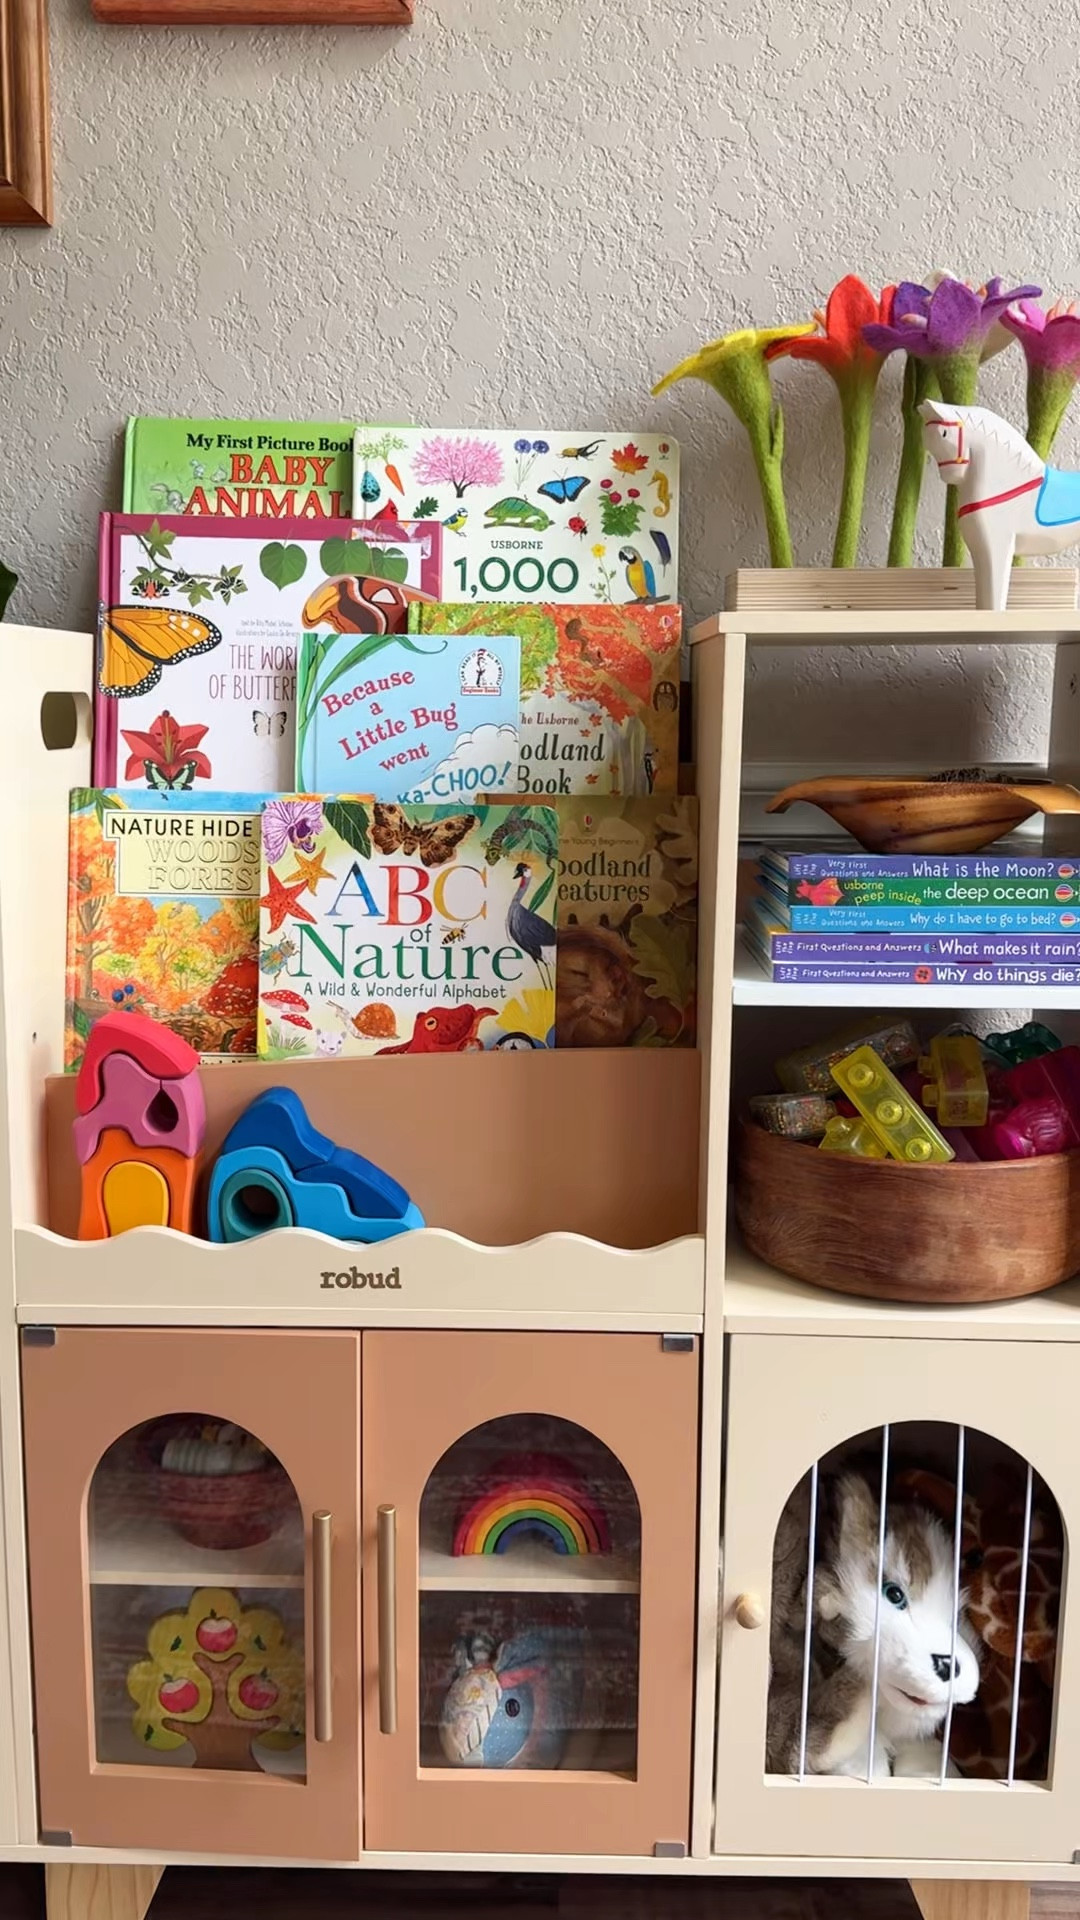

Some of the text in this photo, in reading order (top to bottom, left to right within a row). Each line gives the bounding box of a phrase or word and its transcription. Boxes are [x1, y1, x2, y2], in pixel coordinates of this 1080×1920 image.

[187, 433, 212, 450] My
[217, 434, 252, 450] First
[256, 436, 315, 451] Picture
[229, 454, 335, 486] BABY
[491, 540, 544, 550] USBORNE
[453, 556, 579, 597] 1,000
[229, 644, 255, 670] THE
[209, 674, 227, 699] OF
[321, 670, 415, 717] Because
[369, 702, 383, 716] a
[537, 712, 579, 725] Usborne
[338, 703, 458, 760] Little Bug
[379, 742, 430, 771] went
[111, 818, 194, 836] NATURE
[146, 839, 260, 864] WOODS
[820, 868, 909, 878] Questions and Answers
[828, 859, 846, 869] Very
[912, 861, 1055, 877] What is the Moon?
[148, 866, 261, 891] FORES
[844, 879, 884, 890] usborne
[324, 860, 487, 926] ABC
[854, 882, 1049, 906] peep inside the deep ocean
[821, 918, 905, 927] Questions and Answers
[829, 909, 846, 918] Very
[910, 911, 1057, 928] Why do I have to go to bed?
[410, 923, 432, 943] of
[291, 923, 524, 981] Nature
[797, 943, 819, 951] First
[820, 943, 863, 952] Questions
[864, 943, 881, 951] and
[883, 943, 922, 951] Answers
[939, 938, 979, 955] What
[983, 941, 1028, 955] makes
[1030, 941, 1040, 955] it
[802, 969, 821, 977] First
[822, 969, 859, 978] Questions
[861, 969, 875, 977] and
[877, 969, 910, 978] Answers
[936, 967, 967, 982] Why
[973, 967, 993, 981] do
[997, 968, 1047, 984] things
[304, 982, 506, 1003] A Wild & Wonderful Alphabet
[320, 1266, 402, 1289] robud
